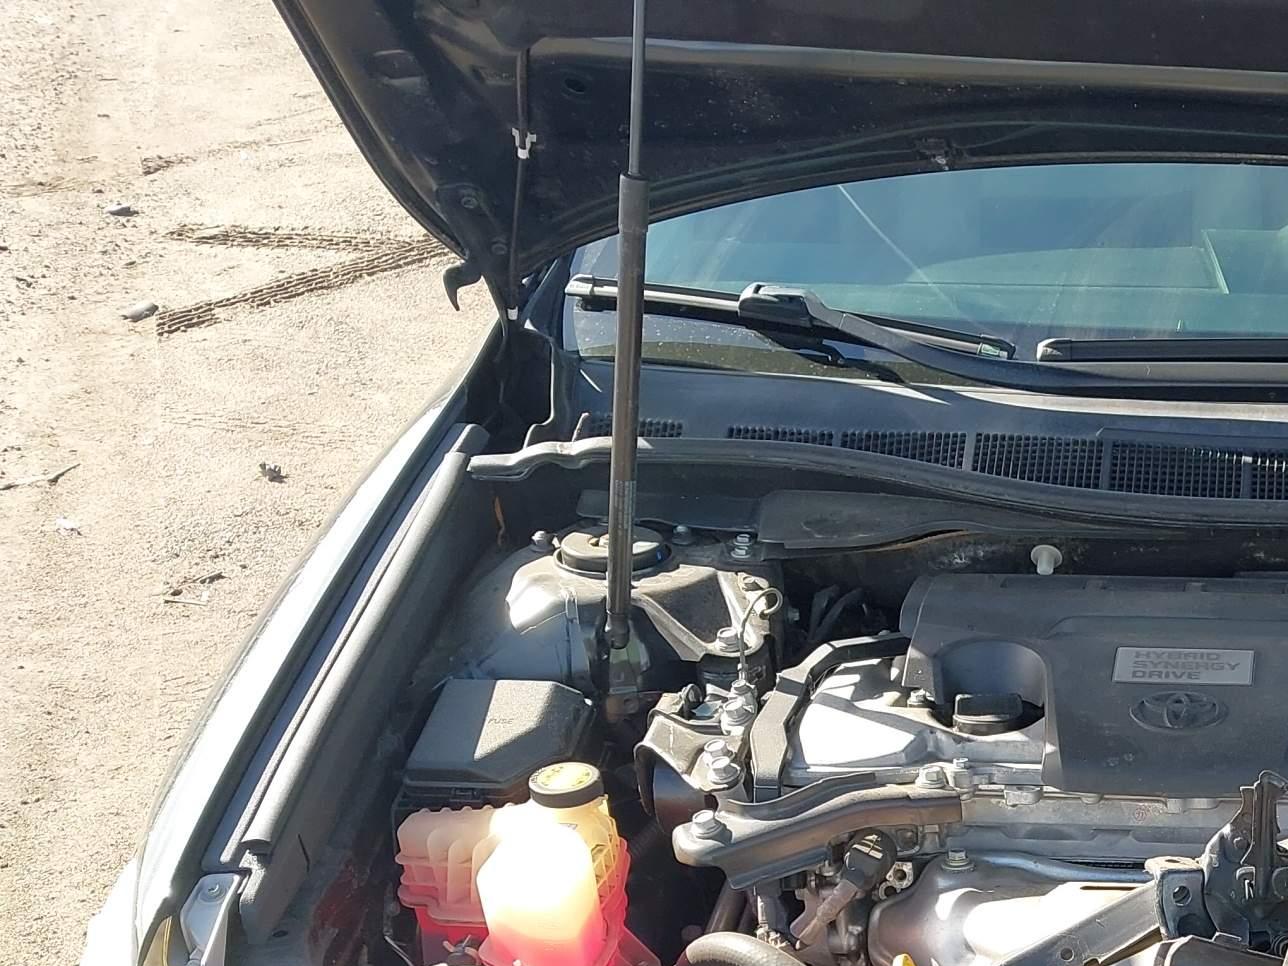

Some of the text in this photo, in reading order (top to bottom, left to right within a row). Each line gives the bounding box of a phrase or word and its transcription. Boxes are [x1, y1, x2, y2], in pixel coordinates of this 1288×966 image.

[1135, 651, 1221, 661] HYBRID
[1133, 660, 1240, 671] SYNERGY
[1131, 670, 1201, 680] DRIVE
